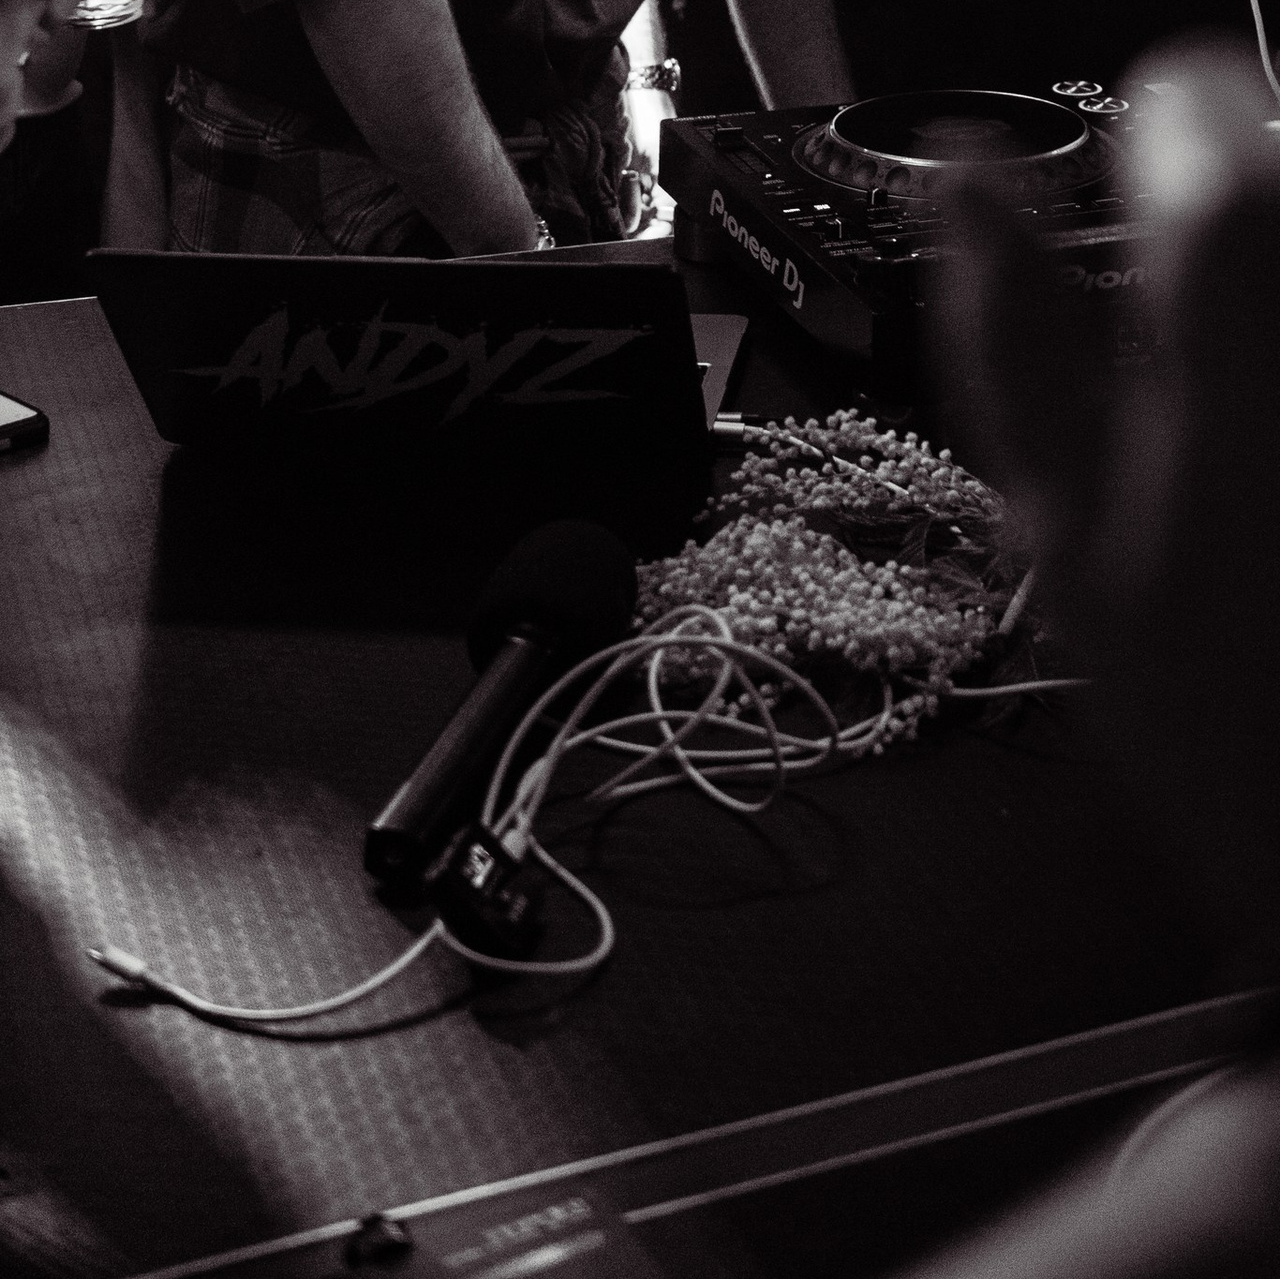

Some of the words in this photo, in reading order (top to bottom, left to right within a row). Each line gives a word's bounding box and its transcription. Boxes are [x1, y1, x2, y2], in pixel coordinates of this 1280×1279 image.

[708, 188, 781, 276] Pioneer
[782, 257, 806, 310] DJ
[1061, 264, 1148, 292] Pion
[168, 299, 655, 426] ANDYZ
